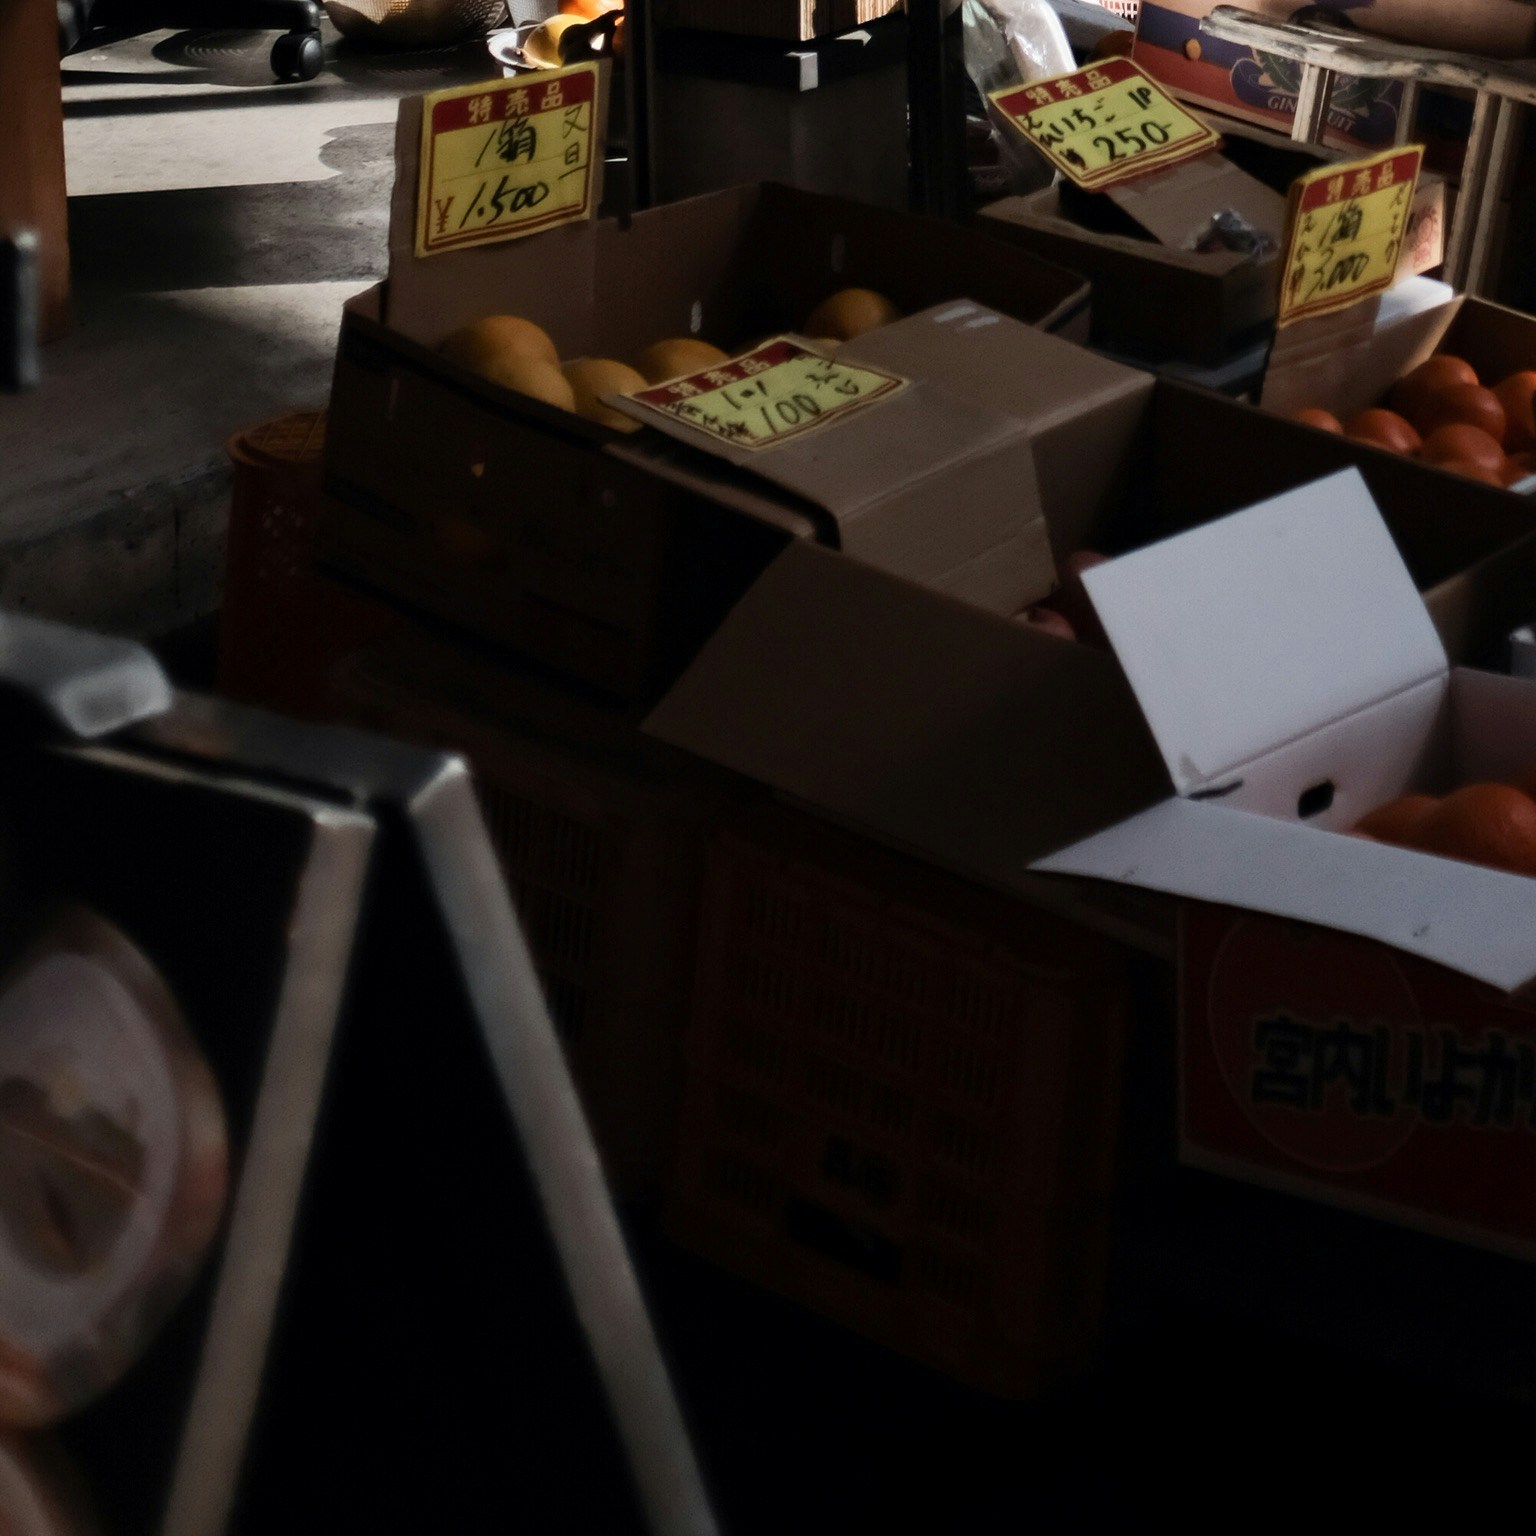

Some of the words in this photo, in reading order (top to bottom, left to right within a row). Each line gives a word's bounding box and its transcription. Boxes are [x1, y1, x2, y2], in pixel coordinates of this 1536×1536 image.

[467, 81, 563, 125] 特売品
[1025, 70, 1112, 106] 特売品
[1326, 159, 1394, 204] 特売品
[435, 196, 456, 234] ¥
[667, 359, 770, 397] 特売品
[761, 394, 822, 435] 100
